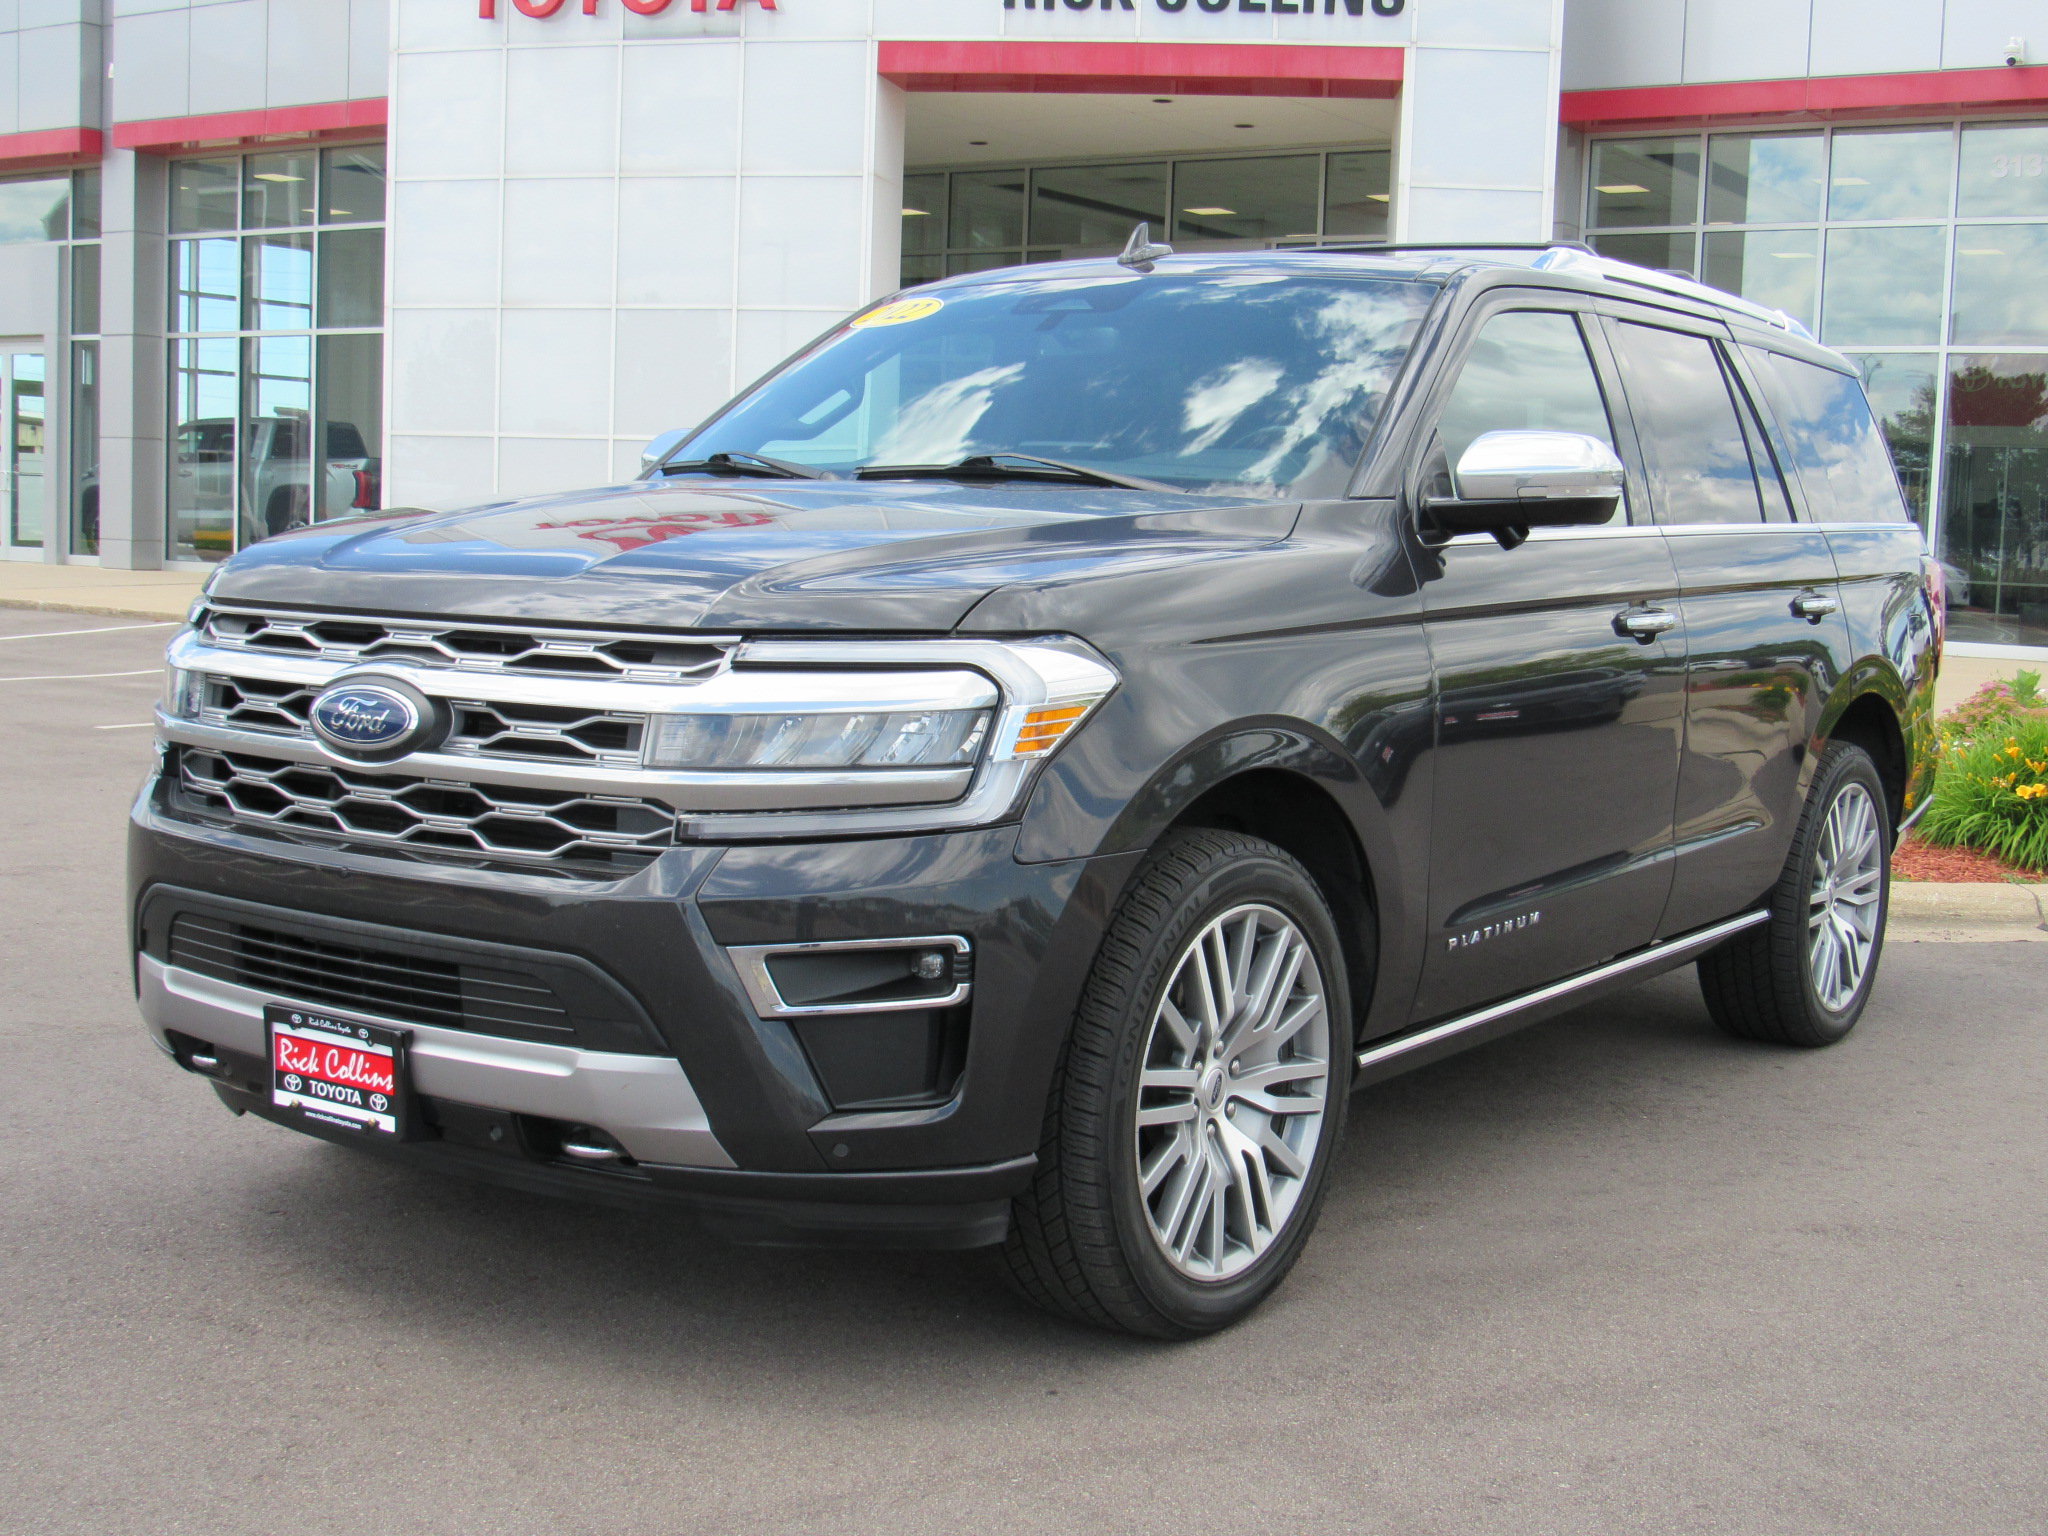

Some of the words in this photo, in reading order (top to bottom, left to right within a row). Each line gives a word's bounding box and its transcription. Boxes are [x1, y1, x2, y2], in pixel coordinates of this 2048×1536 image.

[331, 696, 390, 734] Ford
[1448, 911, 1540, 951] PLATINUM
[280, 1038, 319, 1073] Rick
[325, 1049, 394, 1091] Collins
[309, 1080, 362, 1105] TOYOTA
